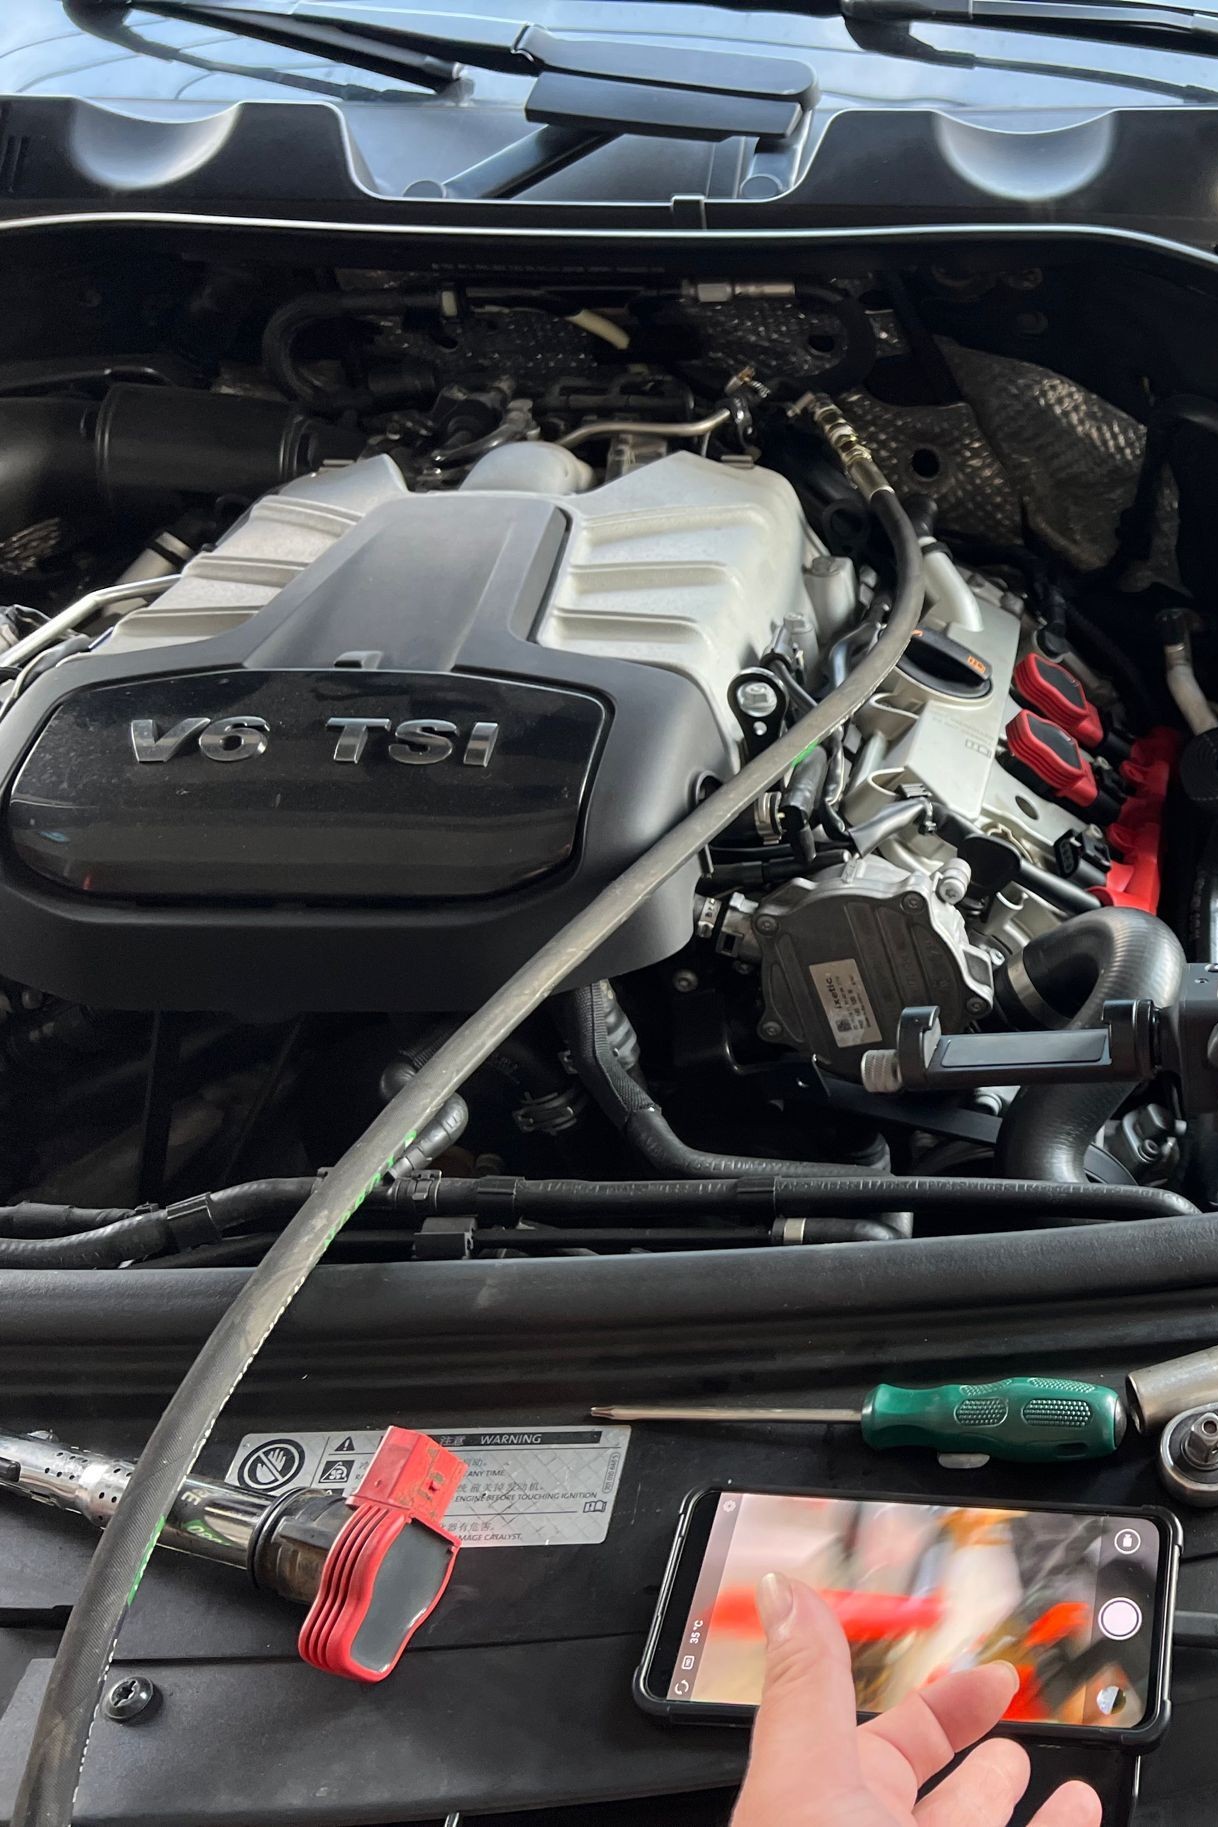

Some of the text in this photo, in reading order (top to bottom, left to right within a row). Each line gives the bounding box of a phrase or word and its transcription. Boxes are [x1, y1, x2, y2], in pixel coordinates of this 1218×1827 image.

[131, 716, 498, 767] V6 TSI
[480, 1433, 543, 1445] WARNING
[468, 1469, 505, 1477] ANY TIME
[455, 1491, 598, 1502] ENGINE BEFORE TOUCHING IGNITION
